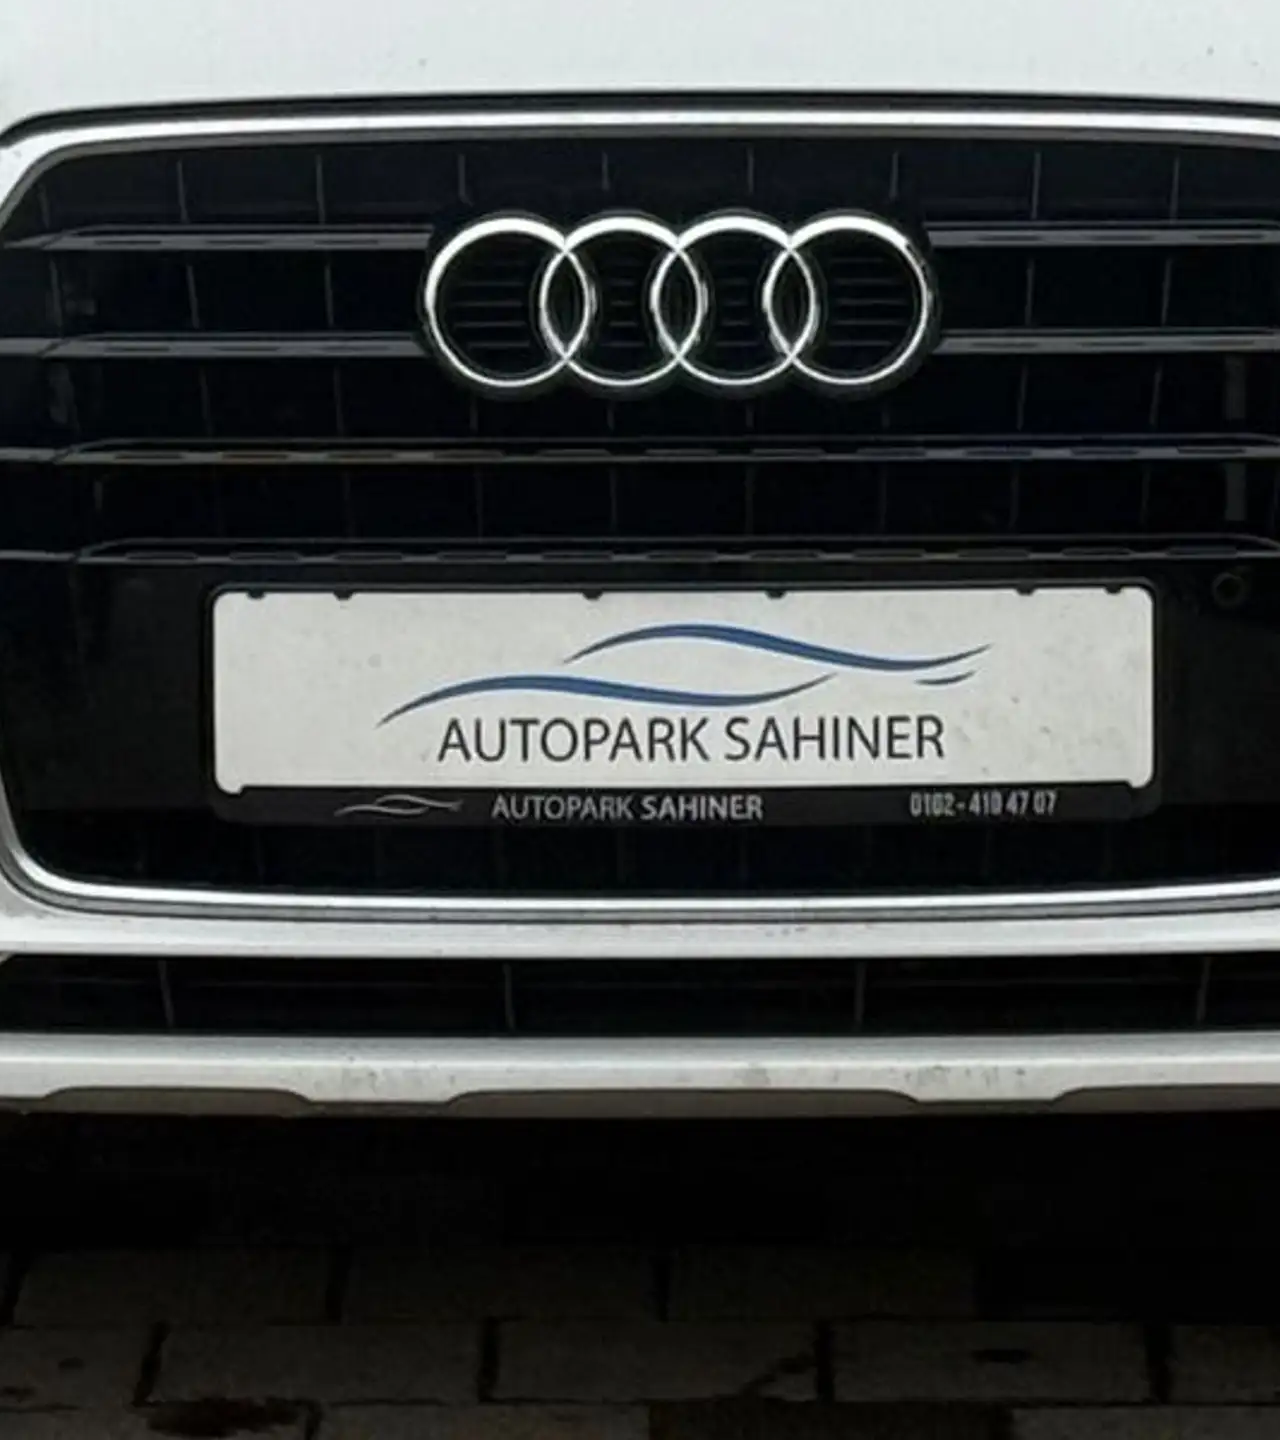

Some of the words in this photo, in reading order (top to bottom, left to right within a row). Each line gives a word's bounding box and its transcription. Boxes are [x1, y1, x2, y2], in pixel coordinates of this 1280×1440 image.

[437, 716, 711, 762] AUTOPARK
[723, 715, 945, 761] SAHINER
[492, 795, 634, 821] AUTOPARK
[639, 794, 764, 821] SAHINER
[1033, 788, 1057, 816] 07
